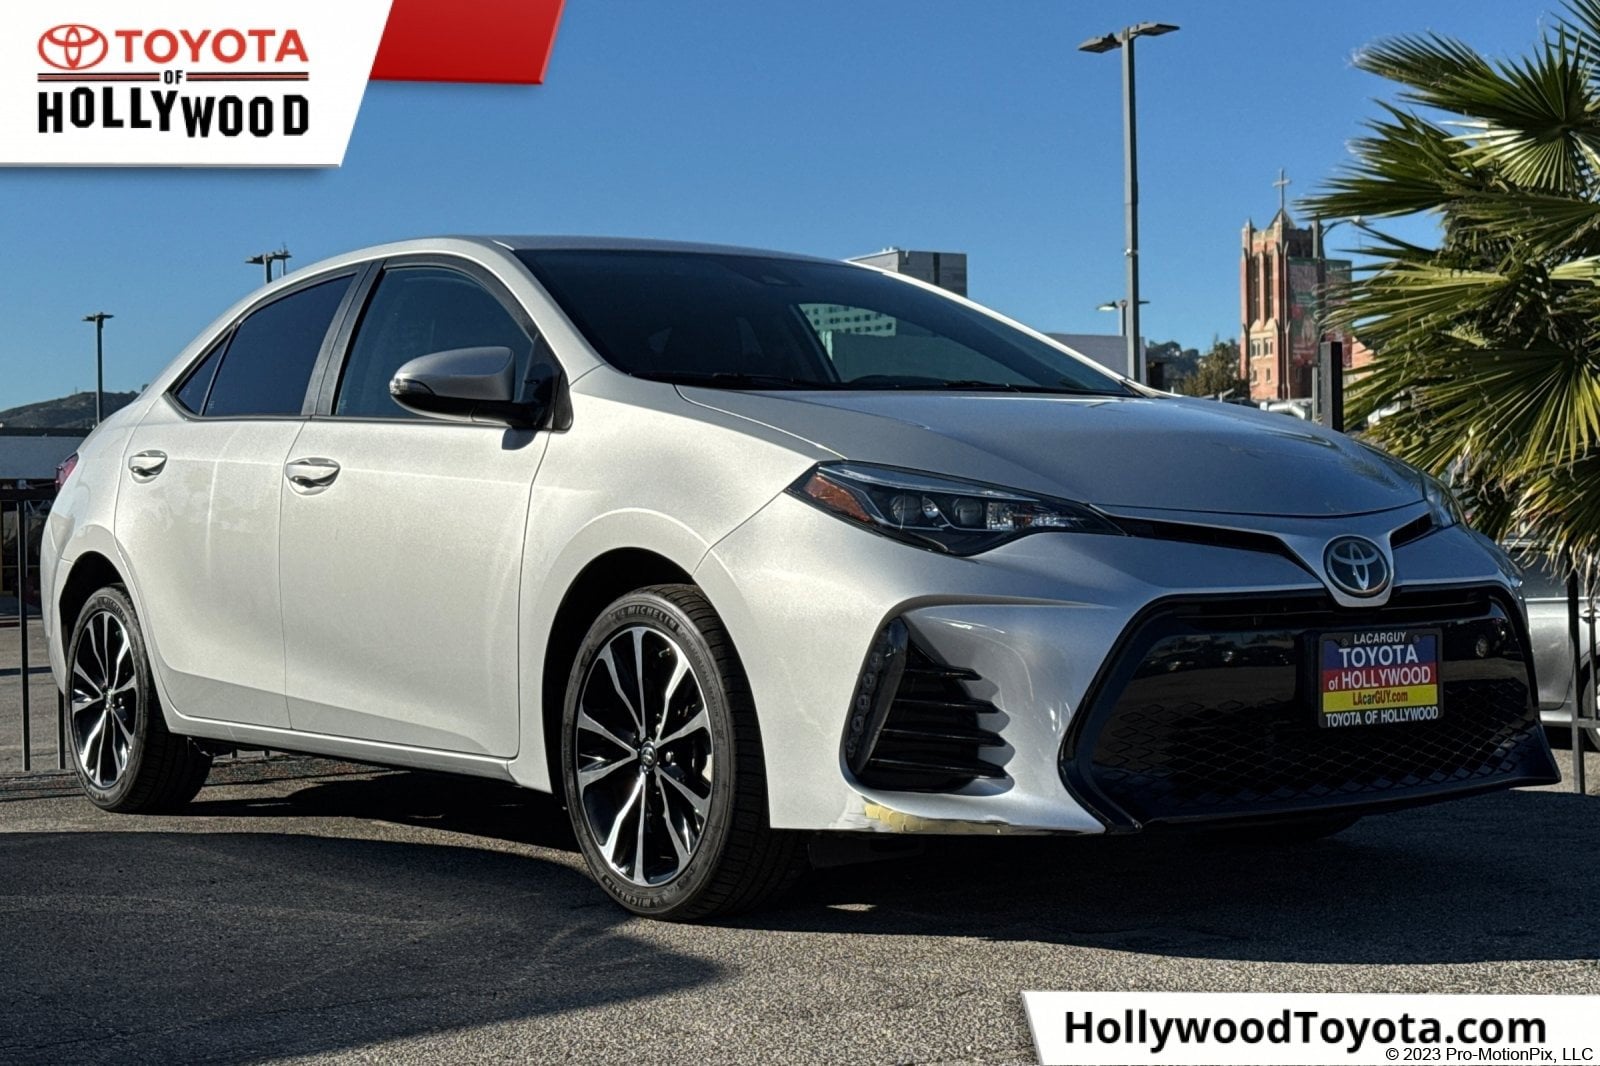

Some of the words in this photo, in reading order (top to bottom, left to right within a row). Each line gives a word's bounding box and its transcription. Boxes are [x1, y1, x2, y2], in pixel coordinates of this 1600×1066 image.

[627, 606, 677, 629] MICHELIN
[1353, 632, 1407, 645] LACARGUY
[1339, 644, 1419, 668] TOYOTA
[1328, 676, 1339, 691] of
[1341, 666, 1431, 689] HOLLYWOOD
[1352, 690, 1408, 706] LAcarGUY.com
[1326, 711, 1362, 727] TOYOTA
[1364, 710, 1378, 724] OF
[1380, 706, 1439, 723] HOLLYWOOD
